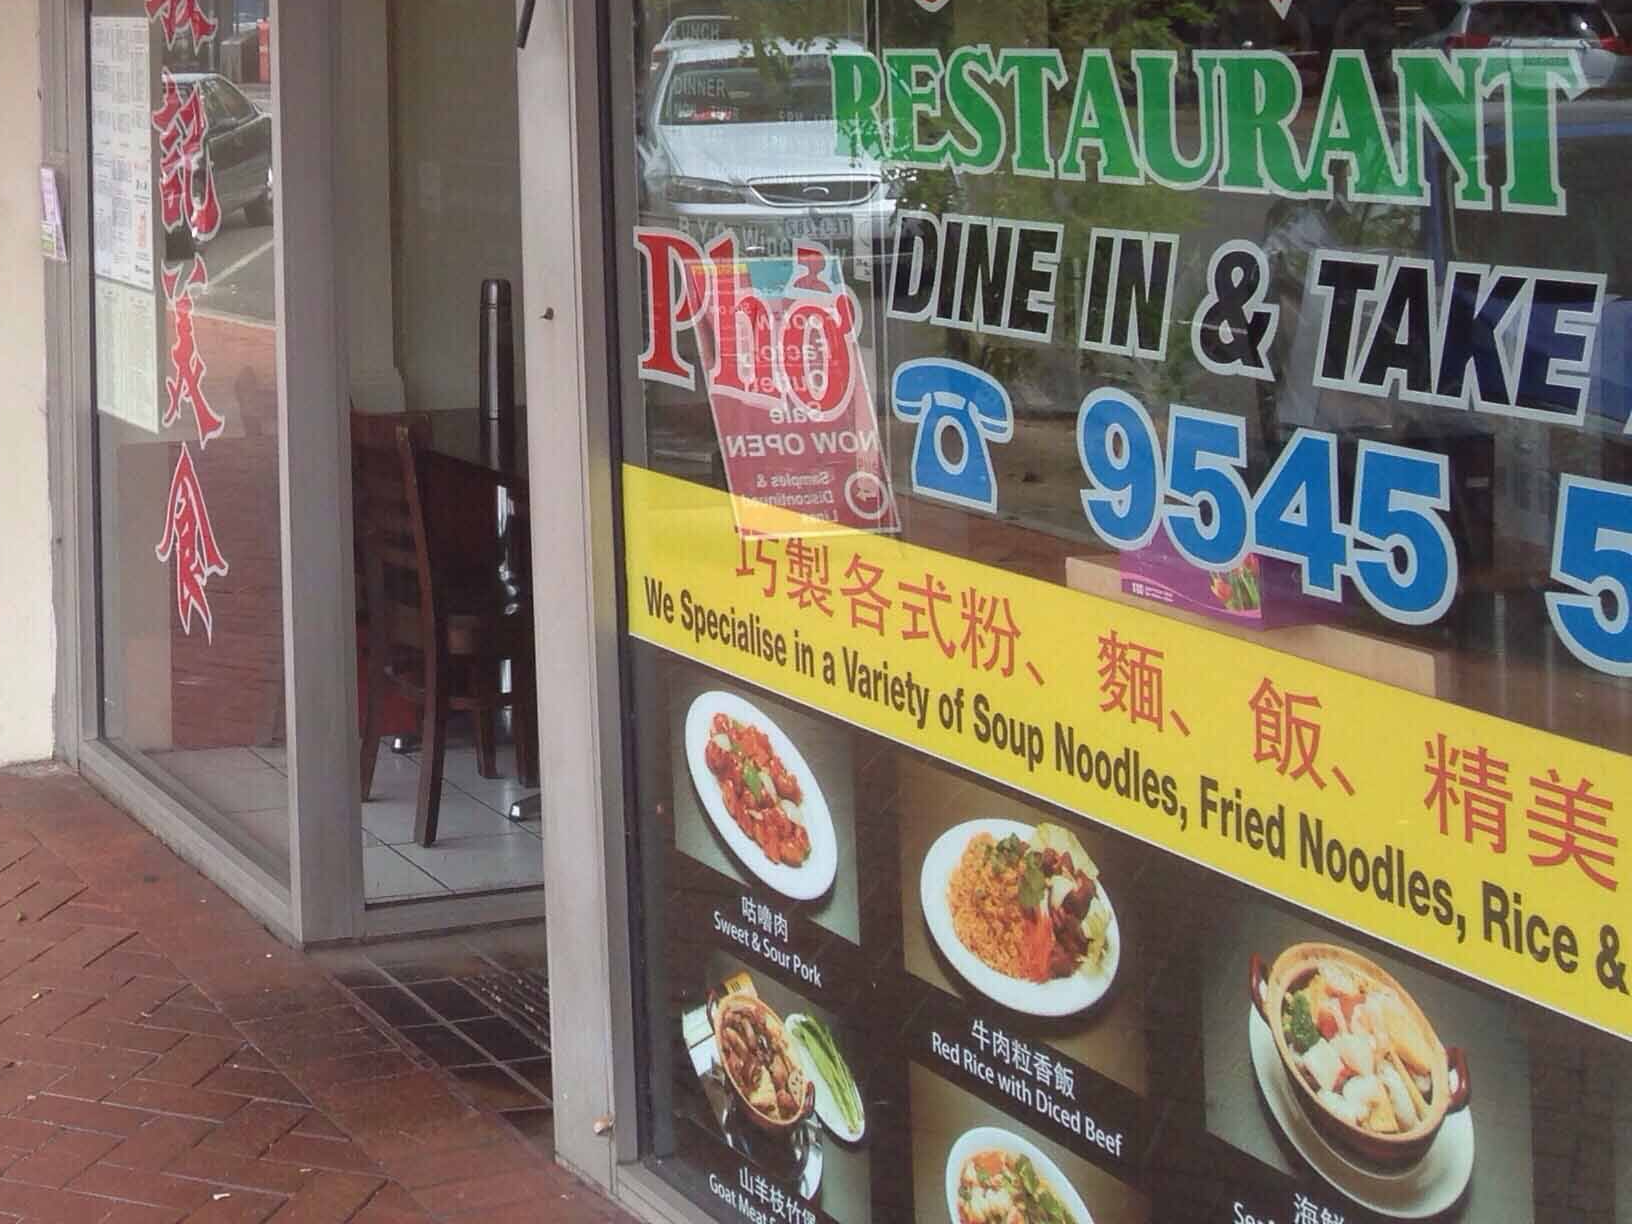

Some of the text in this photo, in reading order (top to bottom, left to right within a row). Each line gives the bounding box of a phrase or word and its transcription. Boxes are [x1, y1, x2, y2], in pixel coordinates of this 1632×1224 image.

[831, 45, 1589, 217] RESTAURANT
[886, 209, 1608, 425] DINE IN & TAKE
[1077, 386, 1460, 626] 9545
[645, 576, 1630, 995] We Specialise in a Variety of Soup Noodles, Fried Noodles, Rice &
[714, 911, 822, 988] Sweet & Sour Pork
[932, 1032, 1122, 1156] Red Rice with Diced Beef
[972, 1019, 1075, 1100] 牛肉粒香飯
[709, 1173, 767, 1224] Goat Meat
